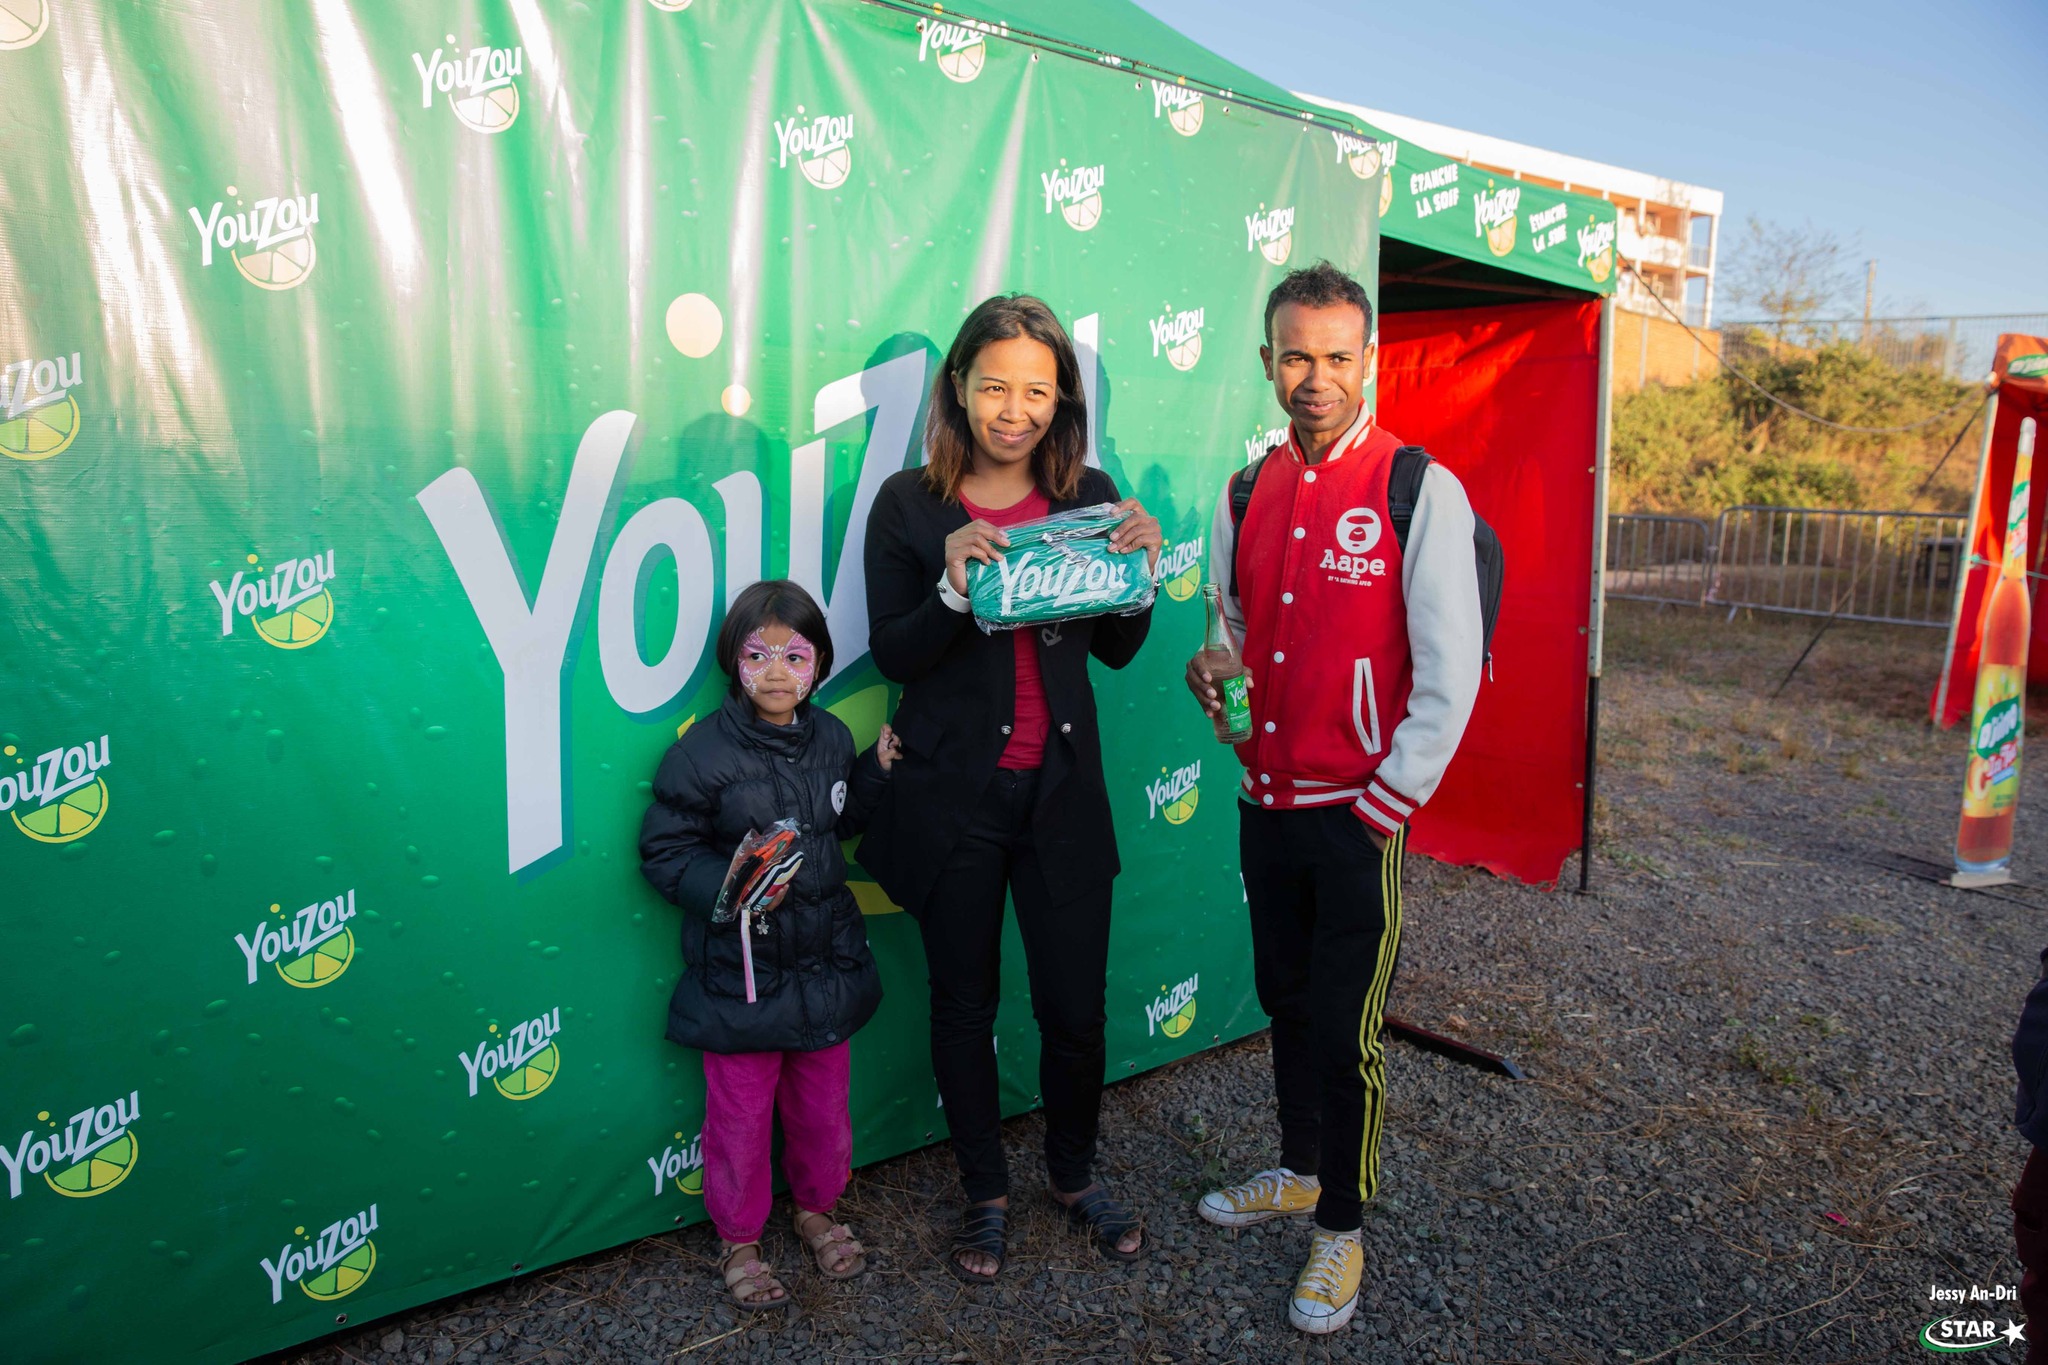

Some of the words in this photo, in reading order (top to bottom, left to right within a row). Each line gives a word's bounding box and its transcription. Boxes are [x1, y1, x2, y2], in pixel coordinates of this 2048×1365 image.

[411, 46, 523, 109] YouZou
[773, 113, 854, 171] YouZou
[1040, 163, 1105, 214] YouZou
[1416, 197, 1433, 219] LA
[1433, 187, 1459, 212] SOIF
[1473, 187, 1520, 238] YouZou
[187, 192, 319, 267] YouZou
[1245, 206, 1294, 252] YouZou
[1148, 306, 1205, 358] YouZou
[209, 549, 336, 637] YouZou
[998, 551, 1131, 616] YouZou
[1319, 549, 1385, 579] Aape
[1145, 759, 1201, 820] YouZou
[234, 888, 357, 985] YouZou
[1145, 973, 1199, 1037] YouZou
[459, 1006, 561, 1097] YouZou
[0, 1090, 140, 1199] YouZou
[259, 1204, 379, 1304] YouZou
